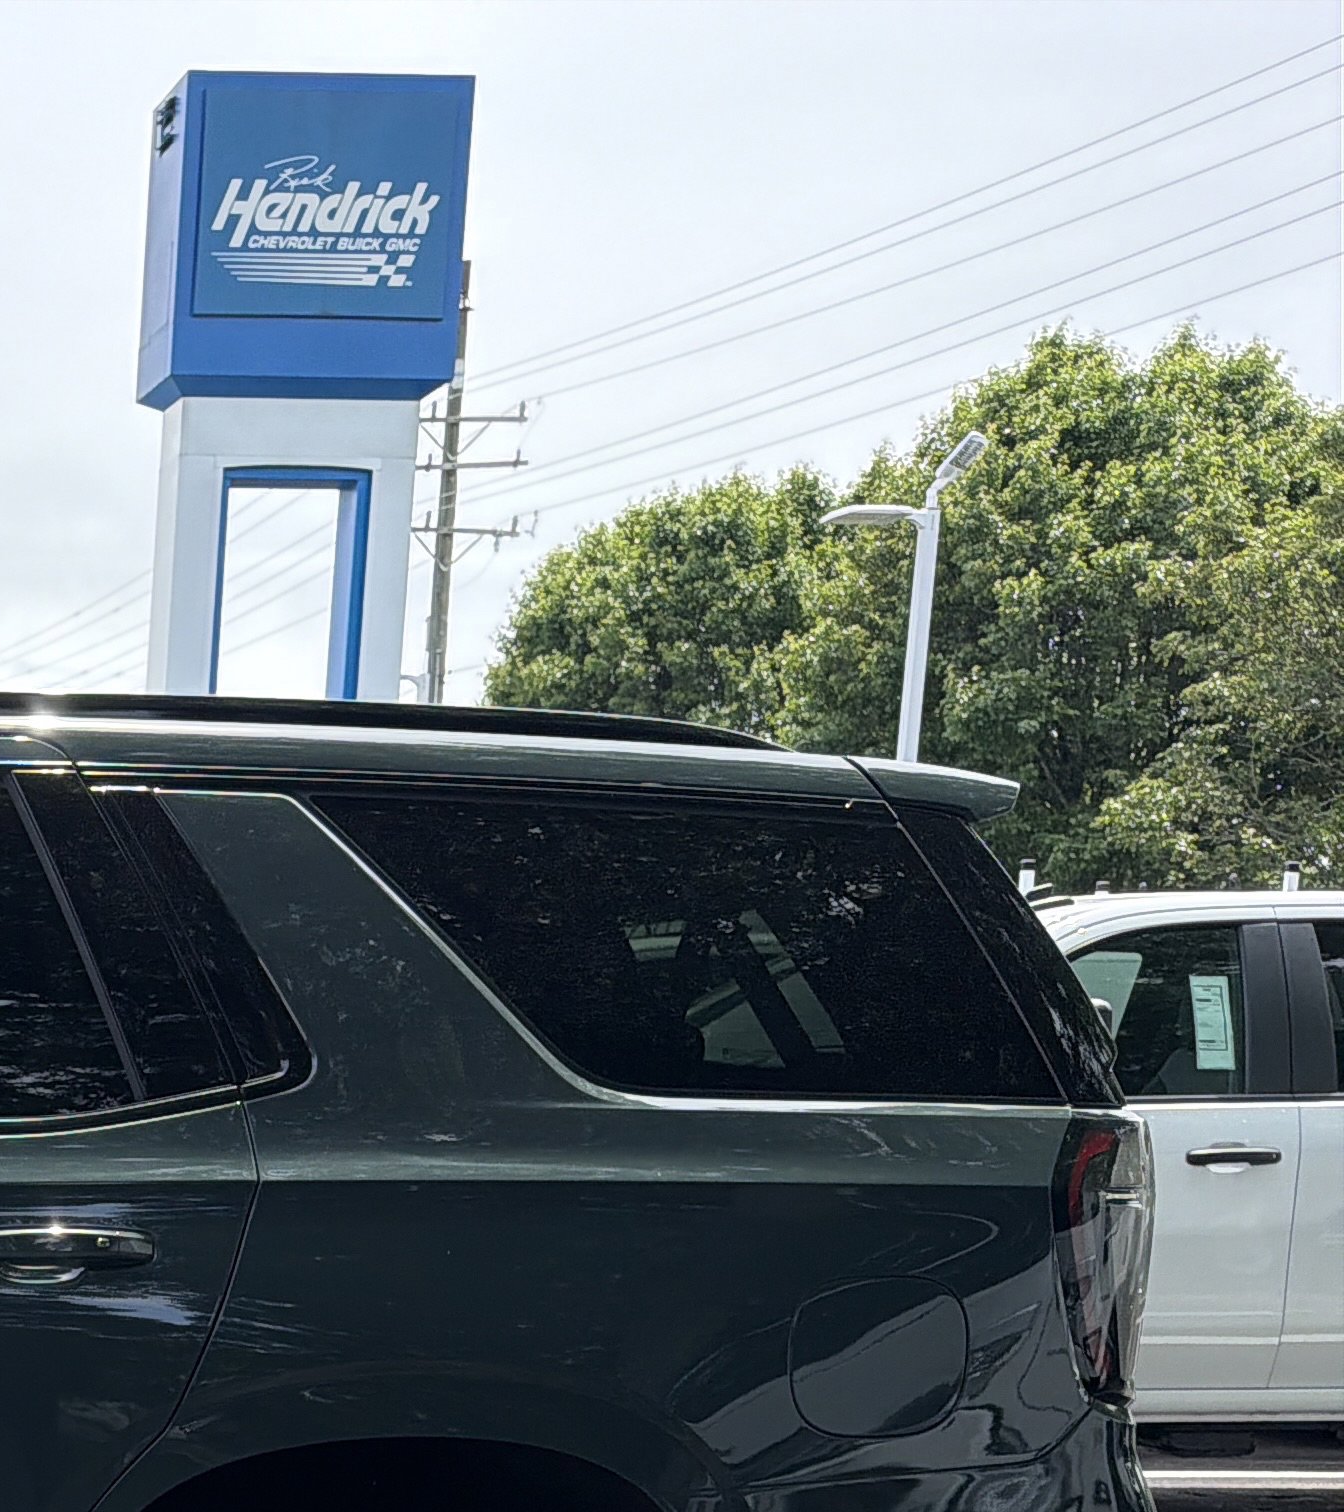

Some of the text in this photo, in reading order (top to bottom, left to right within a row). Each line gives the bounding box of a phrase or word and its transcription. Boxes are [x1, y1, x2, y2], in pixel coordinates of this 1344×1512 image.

[211, 178, 440, 248] Hendrick
[248, 235, 421, 251] CHEVROLET BUICK GMC
